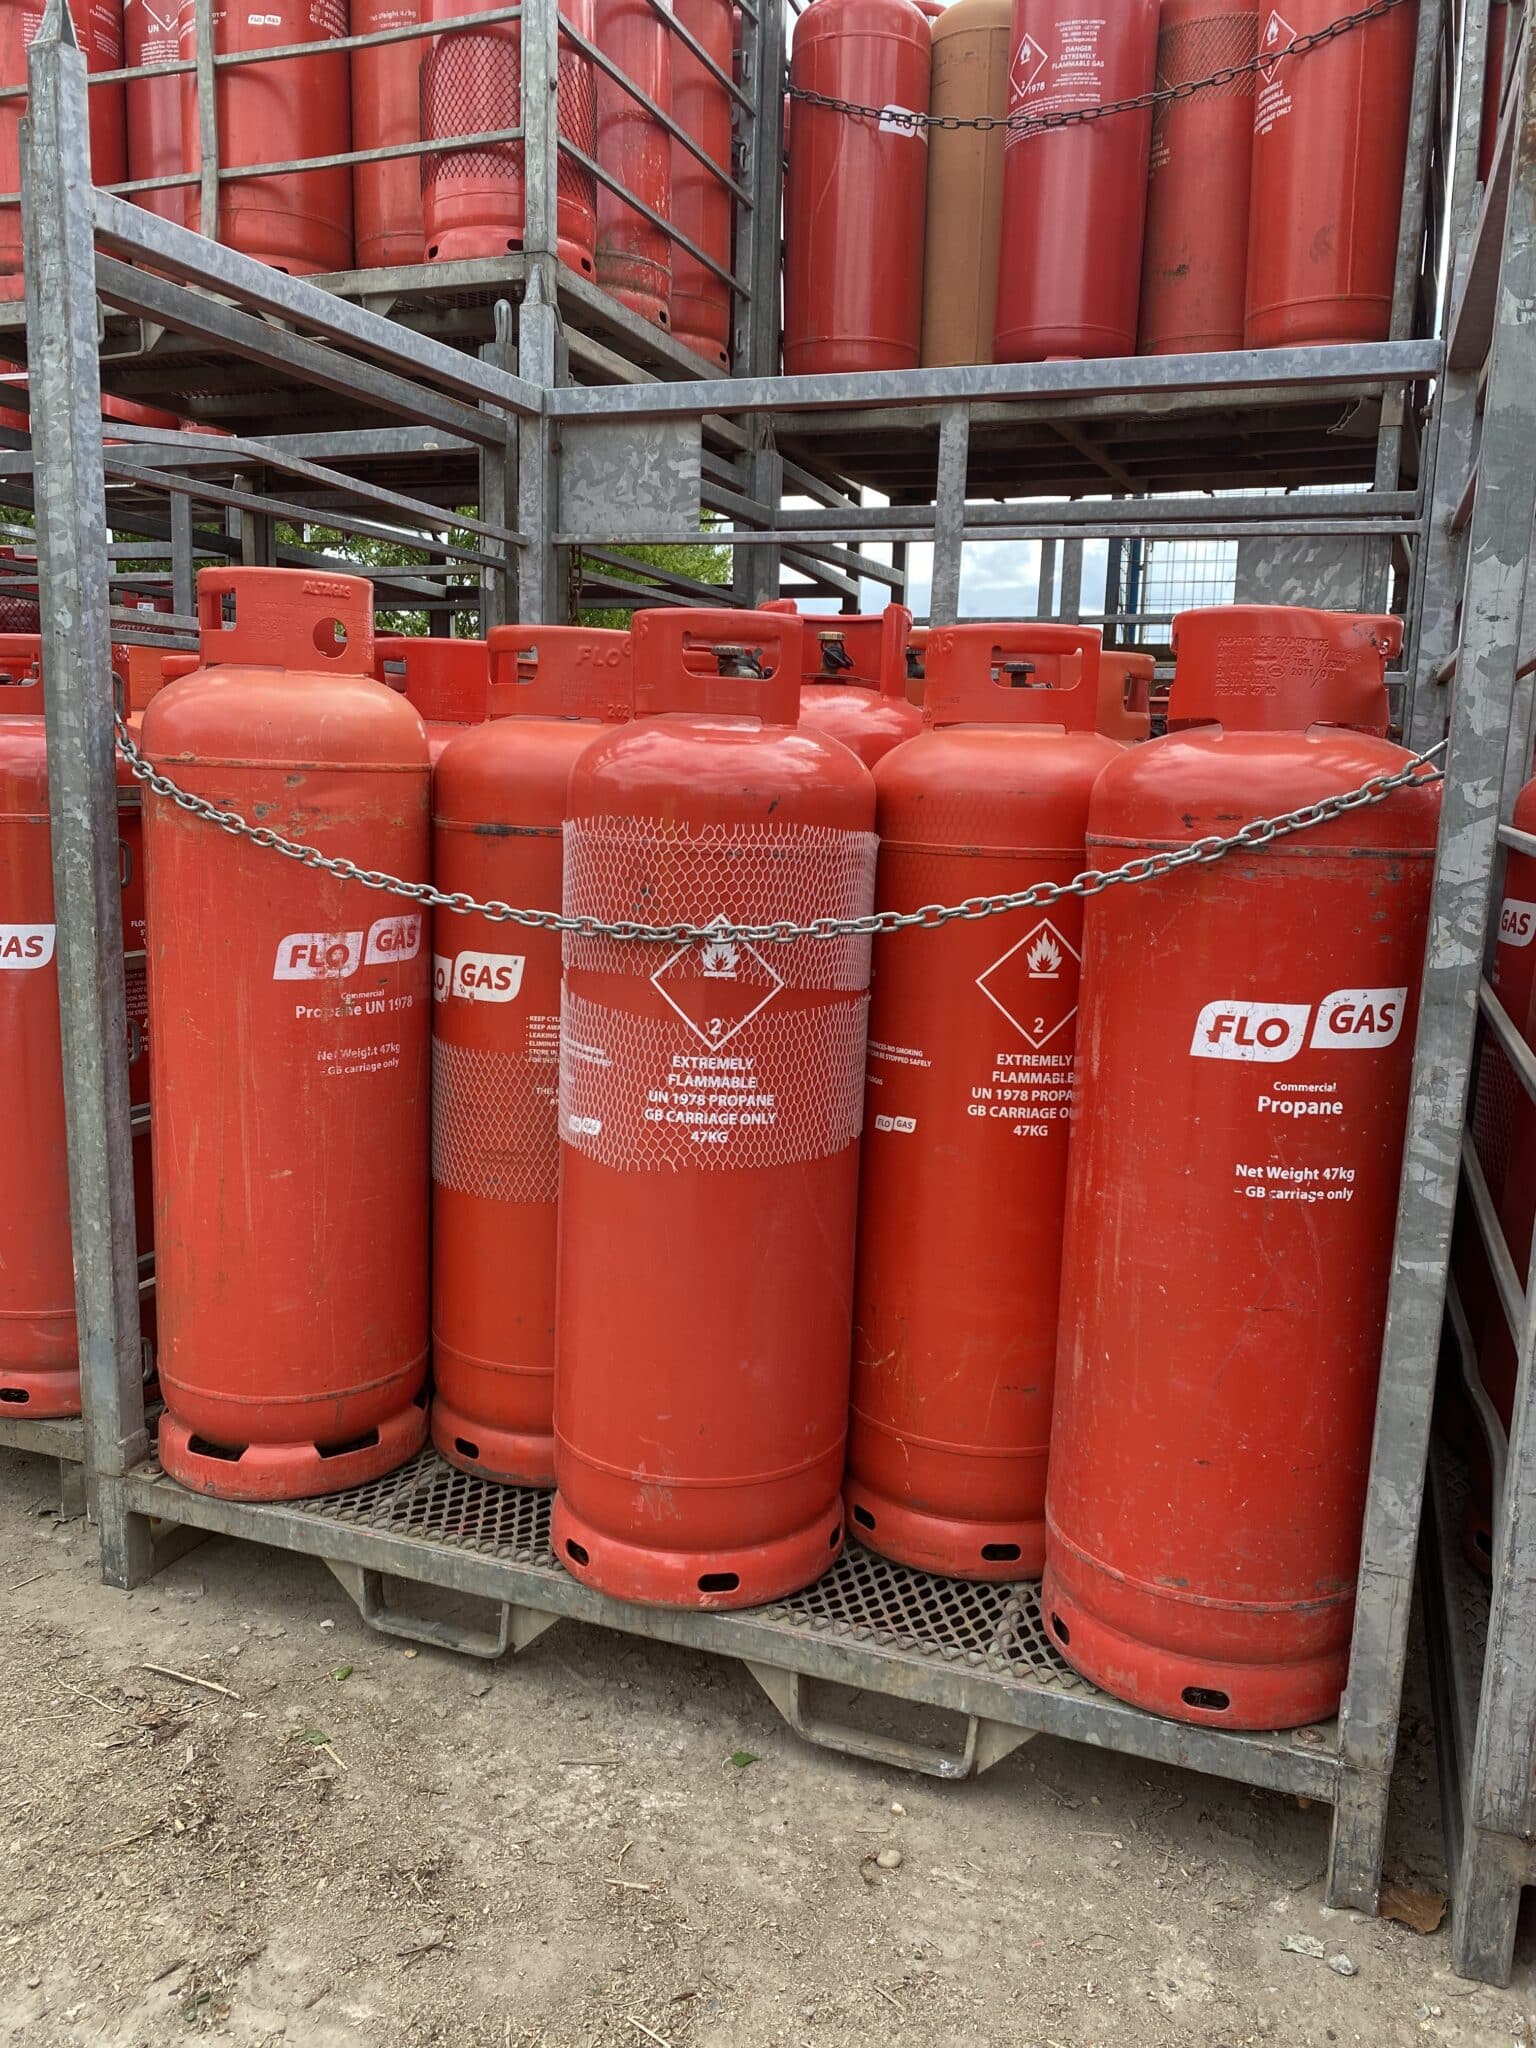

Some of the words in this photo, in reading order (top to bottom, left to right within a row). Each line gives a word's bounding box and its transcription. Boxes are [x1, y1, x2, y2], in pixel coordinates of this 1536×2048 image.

[148, 23, 159, 34] UN
[1065, 45, 1092, 53] DANGER
[1060, 53, 1097, 61] EXTREMELY
[1052, 60, 1091, 70] FLAMMABLE
[1091, 60, 1105, 68] GAS
[1501, 909, 1531, 936] GAS
[0, 935, 44, 958] AS
[289, 944, 350, 969] FLO
[375, 924, 417, 952] GAS
[461, 963, 513, 991] GAS
[340, 989, 385, 1000] Commercial
[365, 1000, 385, 1015] UN
[388, 994, 413, 1012] 1978
[709, 1018, 721, 1035] 2
[1033, 1017, 1045, 1033] 2
[1206, 1013, 1291, 1049] FLO
[1328, 1002, 1396, 1034] GAS
[340, 1046, 379, 1060] Weight
[379, 1042, 401, 1056] 47kg
[327, 1065, 343, 1075] GB
[344, 1061, 382, 1075] carriage
[382, 1057, 400, 1069] only
[672, 1055, 755, 1070] EXTREMELY
[909, 1058, 932, 1068] SAFELY
[996, 1053, 1073, 1067] EXTREMELY
[668, 1074, 757, 1089] FLAMMABLE
[992, 1070, 1075, 1084] FLAMMABLE
[971, 1087, 993, 1100] UN
[995, 1088, 1029, 1101] 1978
[1031, 1089, 1073, 1102] PROPA
[1273, 1081, 1337, 1093] Commercial
[648, 1089, 669, 1103] UN
[672, 1093, 706, 1106] 1978
[709, 1094, 776, 1107] PROPANE
[967, 1104, 987, 1117] GB
[989, 1105, 1057, 1119] CARRIAGE
[1257, 1095, 1344, 1119] Propane
[644, 1108, 664, 1121] GB
[666, 1110, 737, 1125] CARRIAGE
[740, 1112, 777, 1125] ONLY
[896, 1119, 913, 1130] GAS
[1012, 1124, 1049, 1137] 47KG
[690, 1130, 729, 1143] 47KG
[1235, 1163, 1264, 1178] Net
[1266, 1165, 1320, 1183] Weight
[1322, 1166, 1356, 1183] 47kg
[1245, 1185, 1266, 1199] GB
[1269, 1187, 1325, 1203] carriage
[1326, 1186, 1354, 1202] only
